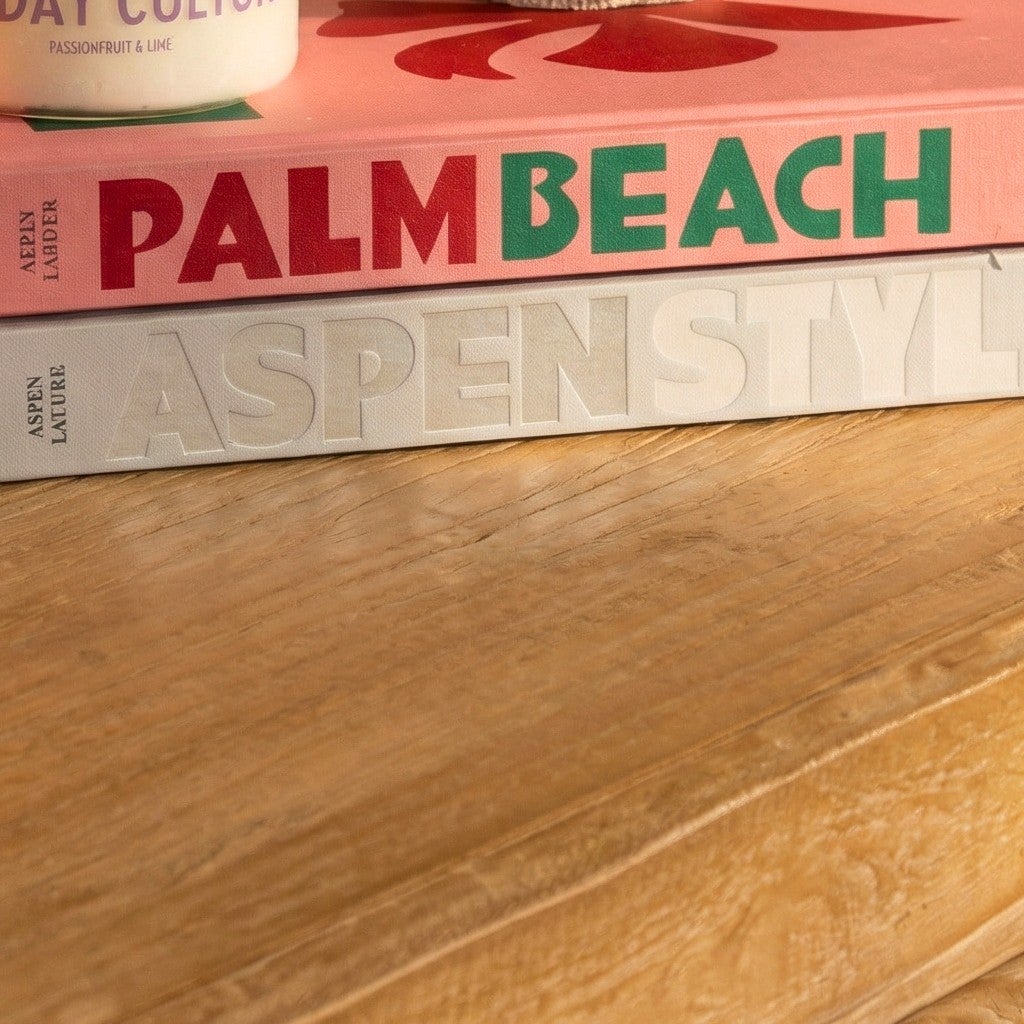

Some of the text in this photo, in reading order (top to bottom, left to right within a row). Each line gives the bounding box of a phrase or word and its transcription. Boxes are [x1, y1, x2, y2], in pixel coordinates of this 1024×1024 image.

[49, 37, 173, 55] PASSIONFRUIT & LIME
[27, 376, 44, 438] ASPEN
